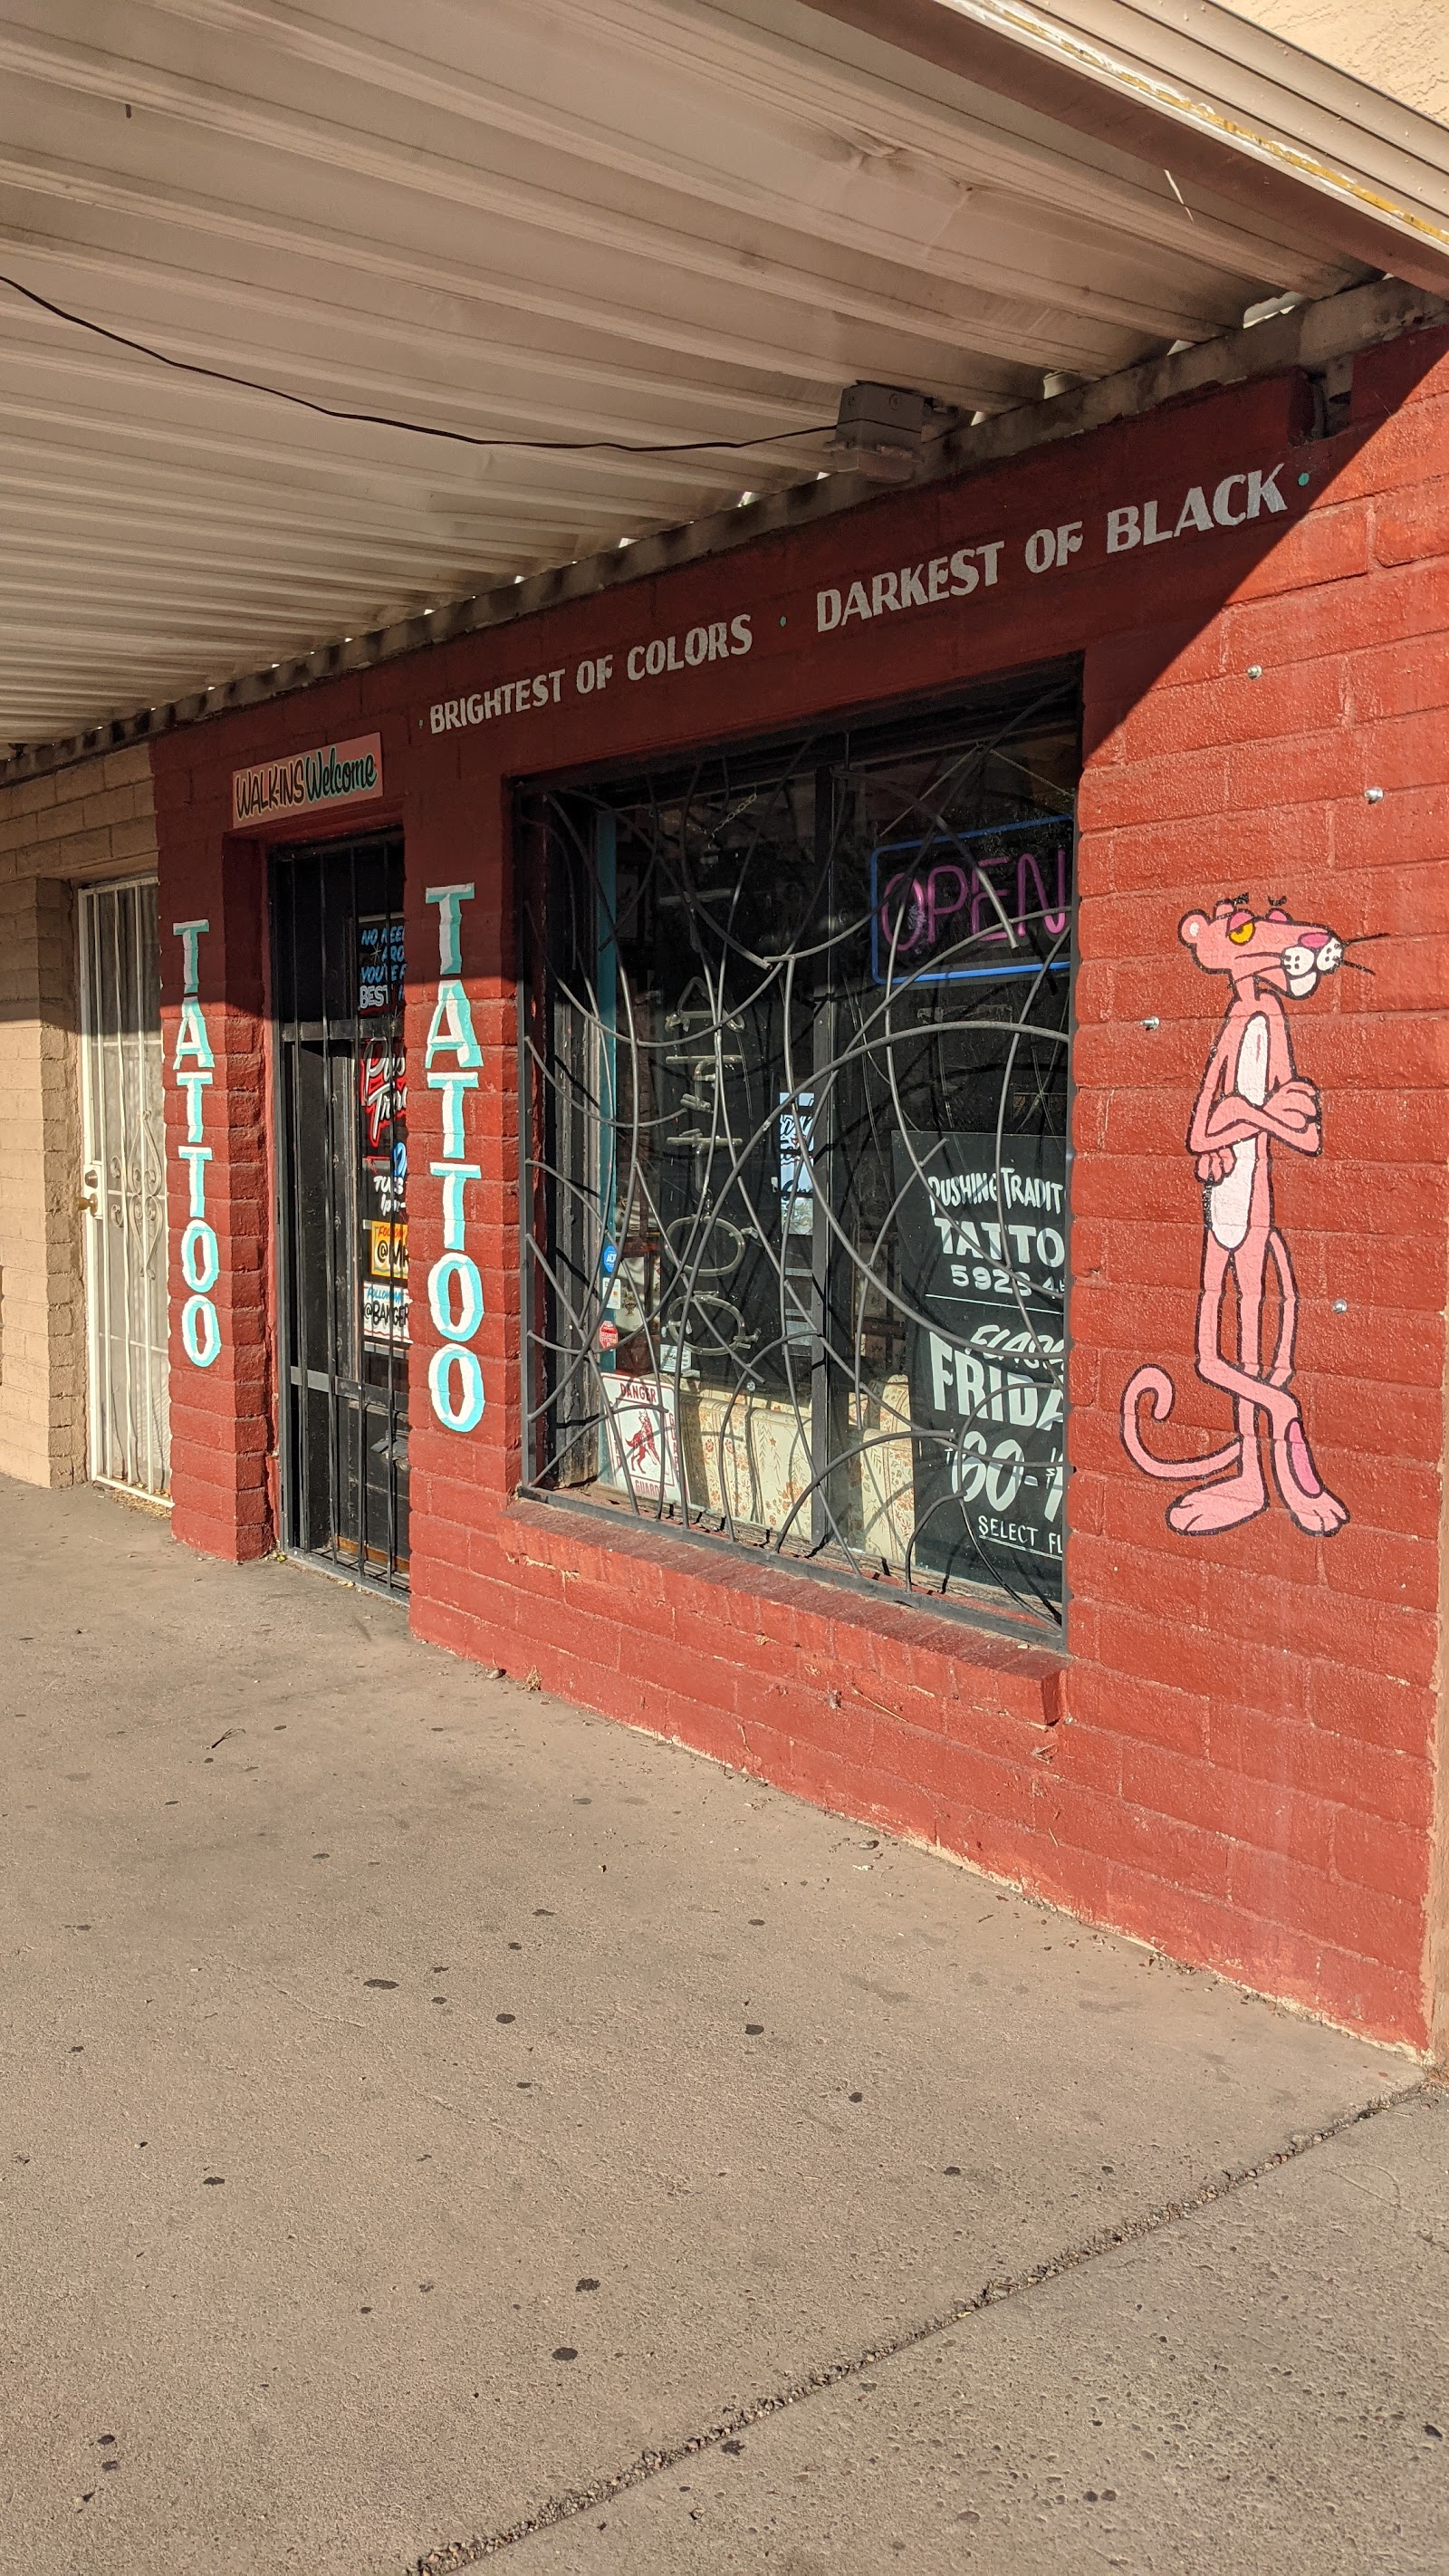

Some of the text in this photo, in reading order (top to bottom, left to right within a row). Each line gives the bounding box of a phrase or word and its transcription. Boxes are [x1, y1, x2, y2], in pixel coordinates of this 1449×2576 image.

[816, 462, 1288, 633] DARKEST OF BLACK
[429, 613, 753, 735] BRIGHTEST OF COLORS
[305, 745, 379, 803] Welcome
[881, 848, 1066, 951] OPEN
[361, 928, 379, 946] NO
[172, 918, 221, 1369] TATTOO
[425, 882, 485, 1433] TATTOO
[927, 1167, 1064, 1216] PUSHING TRADIT
[934, 1216, 1066, 1268] TATTO
[619, 1382, 657, 1404] DANGER
[978, 1514, 1039, 1546] SELECT
